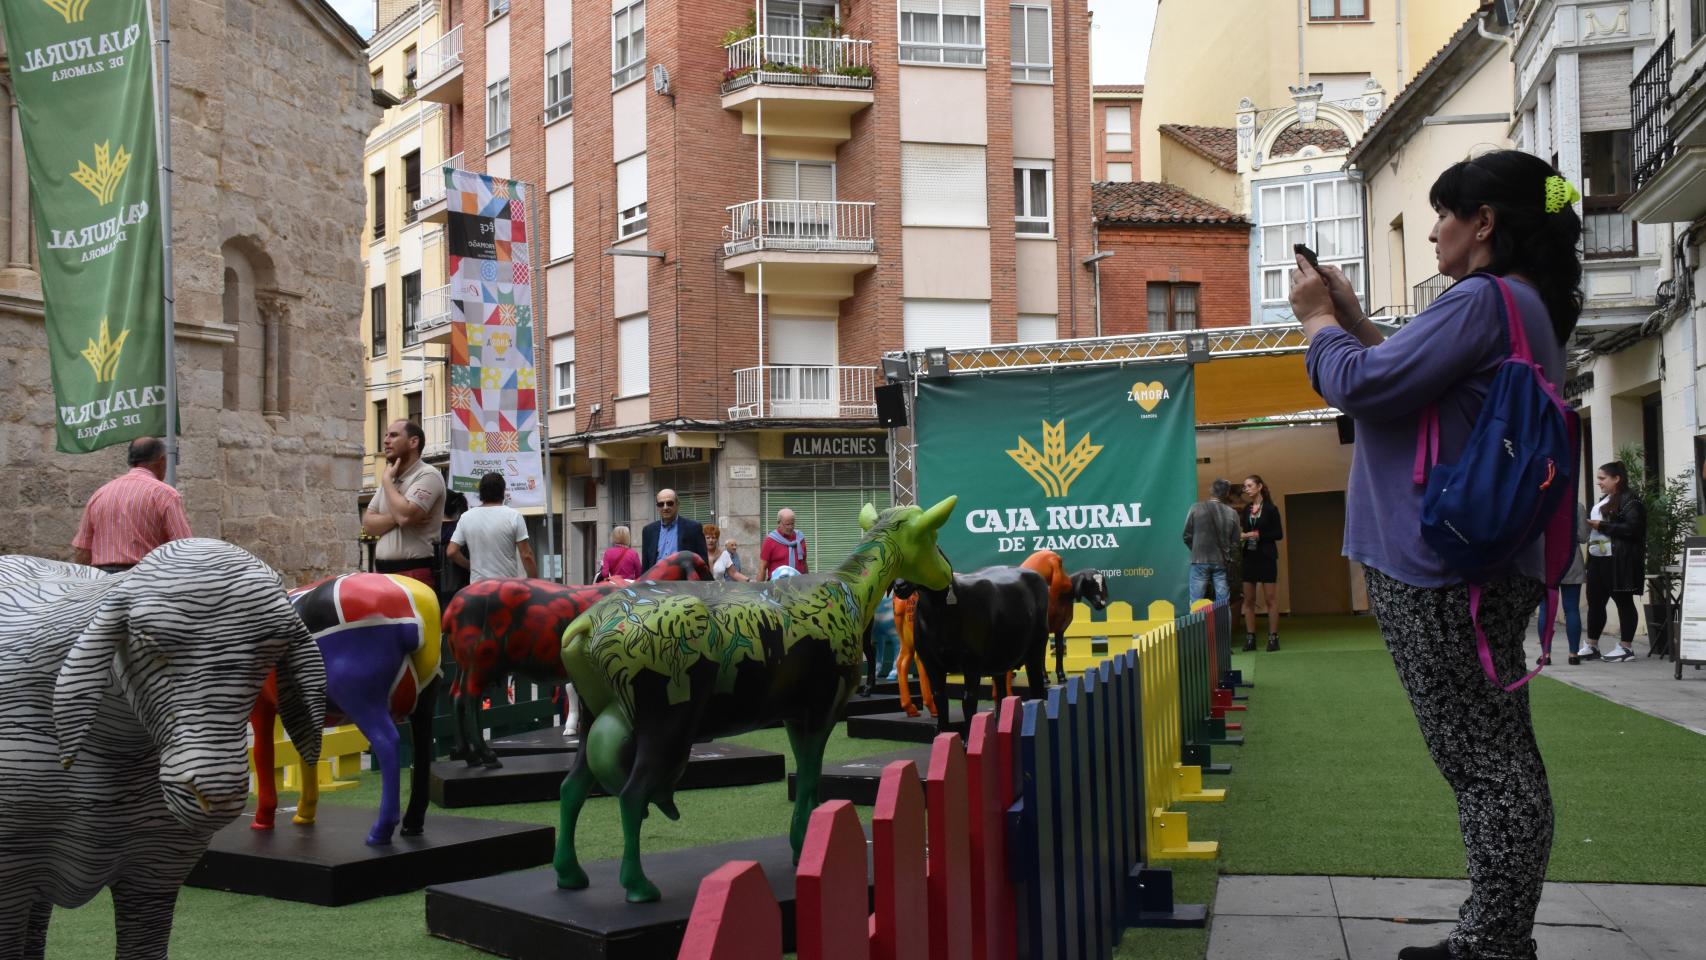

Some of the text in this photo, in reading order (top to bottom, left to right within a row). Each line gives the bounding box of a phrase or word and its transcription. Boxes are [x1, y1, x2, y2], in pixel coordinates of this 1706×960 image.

[1127, 389, 1170, 402] ZAMORA
[792, 437, 877, 455] ALMACENES
[965, 502, 1151, 534] CAJA RURAL
[998, 533, 1119, 552] DE ZAMORA
[1123, 567, 1154, 578] contigo
